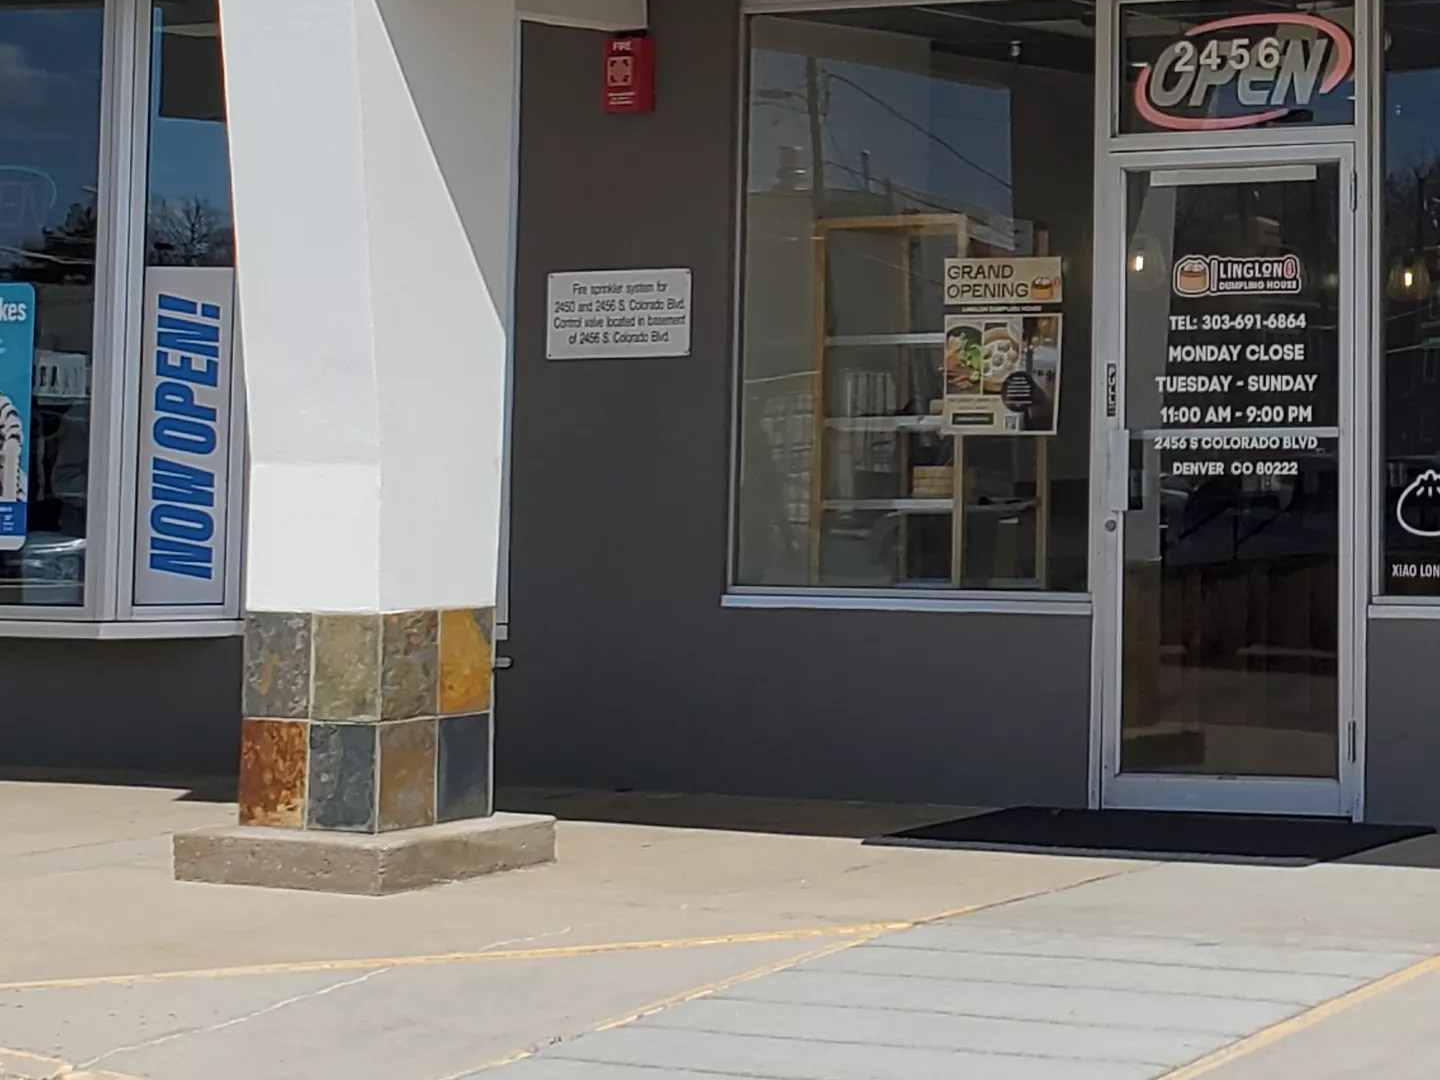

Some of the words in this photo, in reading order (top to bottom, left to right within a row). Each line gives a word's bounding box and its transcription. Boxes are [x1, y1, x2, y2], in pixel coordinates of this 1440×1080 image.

[1173, 37, 1280, 72] 2456
[1150, 38, 1328, 107] OPEN
[947, 264, 1014, 280] GRAND
[947, 282, 1029, 299] OPENING
[1169, 315, 1198, 331] TEL:
[1202, 313, 1307, 330] 303-691-6864
[1168, 344, 1242, 362] MONDAY
[1245, 344, 1305, 361] CLOSE
[152, 293, 221, 456] OPEN!
[1155, 375, 1233, 392] TUESDAY
[1247, 374, 1318, 392] SUNDAY
[1160, 406, 1201, 423] 11:00
[1204, 406, 1231, 423] AM
[1246, 405, 1284, 423] 9:00
[1288, 405, 1313, 422] PM
[1153, 436, 1187, 450] 2456
[1190, 436, 1199, 450] S
[1201, 436, 1280, 450] COLORADO
[1283, 435, 1319, 449] BLVD
[1172, 461, 1225, 476] DENVER
[1231, 461, 1254, 476] CO
[1256, 461, 1298, 476] 80222
[150, 456, 215, 580] NOW
[1391, 564, 1417, 578] XIAO
